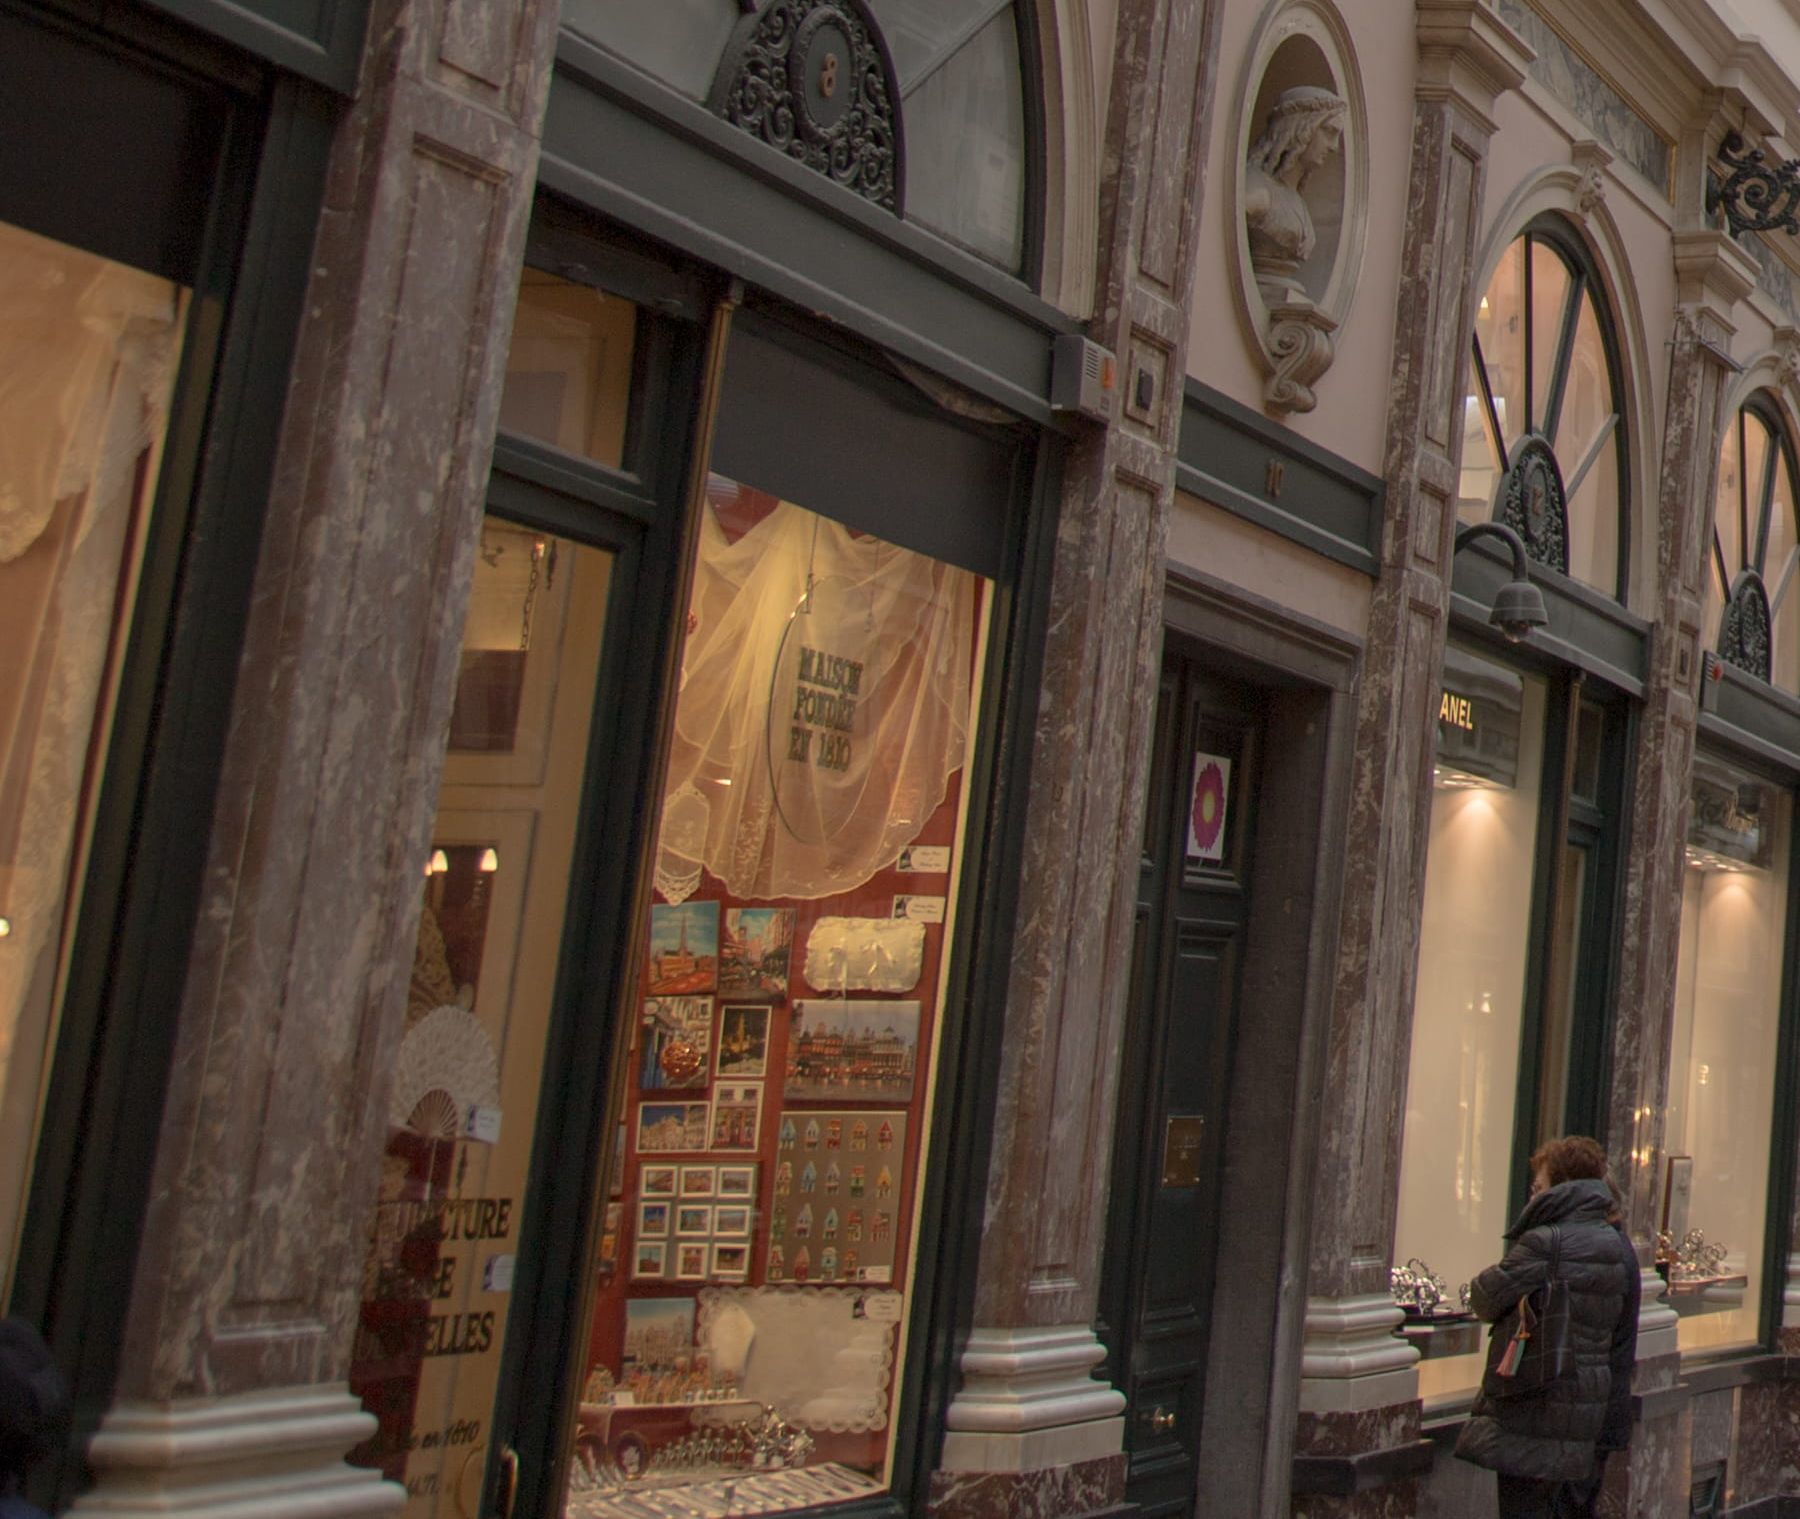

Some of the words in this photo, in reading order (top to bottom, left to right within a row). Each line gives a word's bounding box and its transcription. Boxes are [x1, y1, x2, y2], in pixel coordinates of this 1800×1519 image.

[821, 52, 838, 98] 8
[798, 647, 864, 695] MAISON
[1439, 692, 1474, 730] ANEL
[789, 726, 813, 763] EN
[816, 731, 852, 772] 1810
